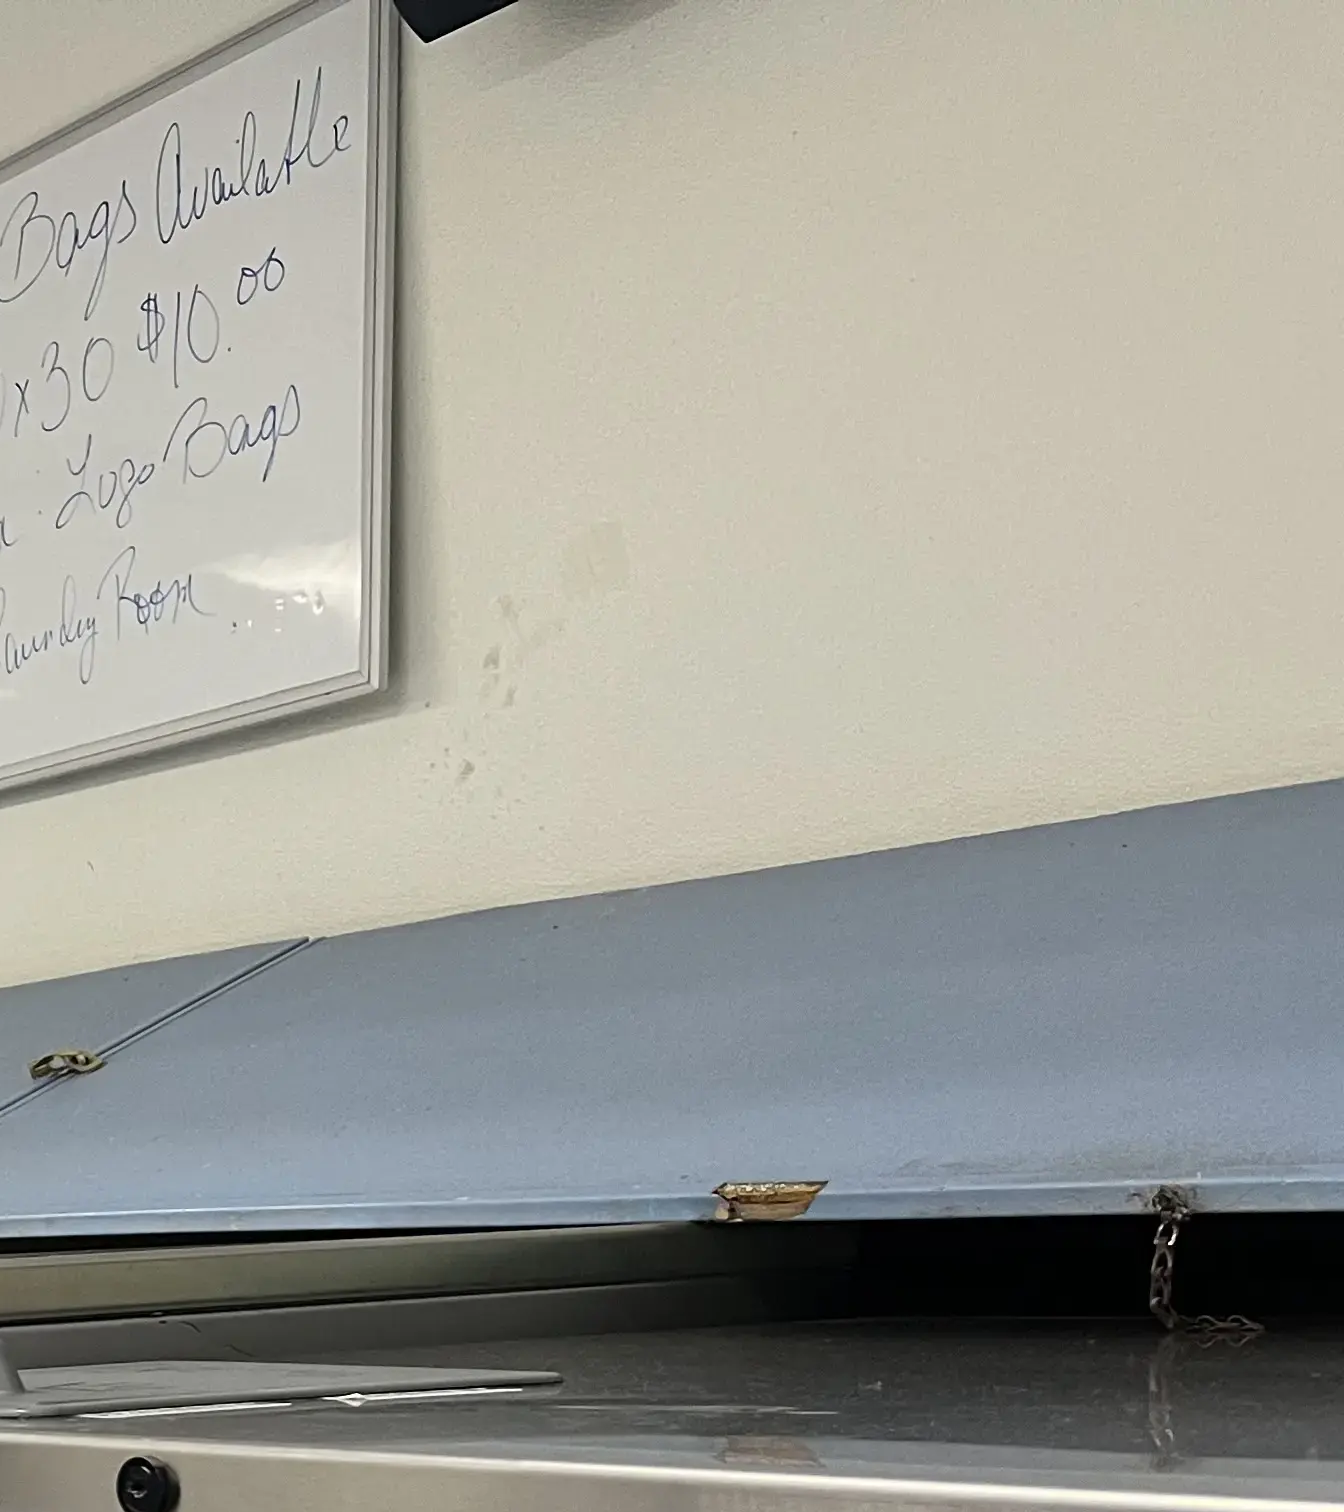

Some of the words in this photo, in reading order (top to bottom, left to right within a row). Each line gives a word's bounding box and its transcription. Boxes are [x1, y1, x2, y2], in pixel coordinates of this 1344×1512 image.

[156, 66, 352, 245] Available
[164, 385, 301, 482] Bags
[97, 546, 216, 640] Room
